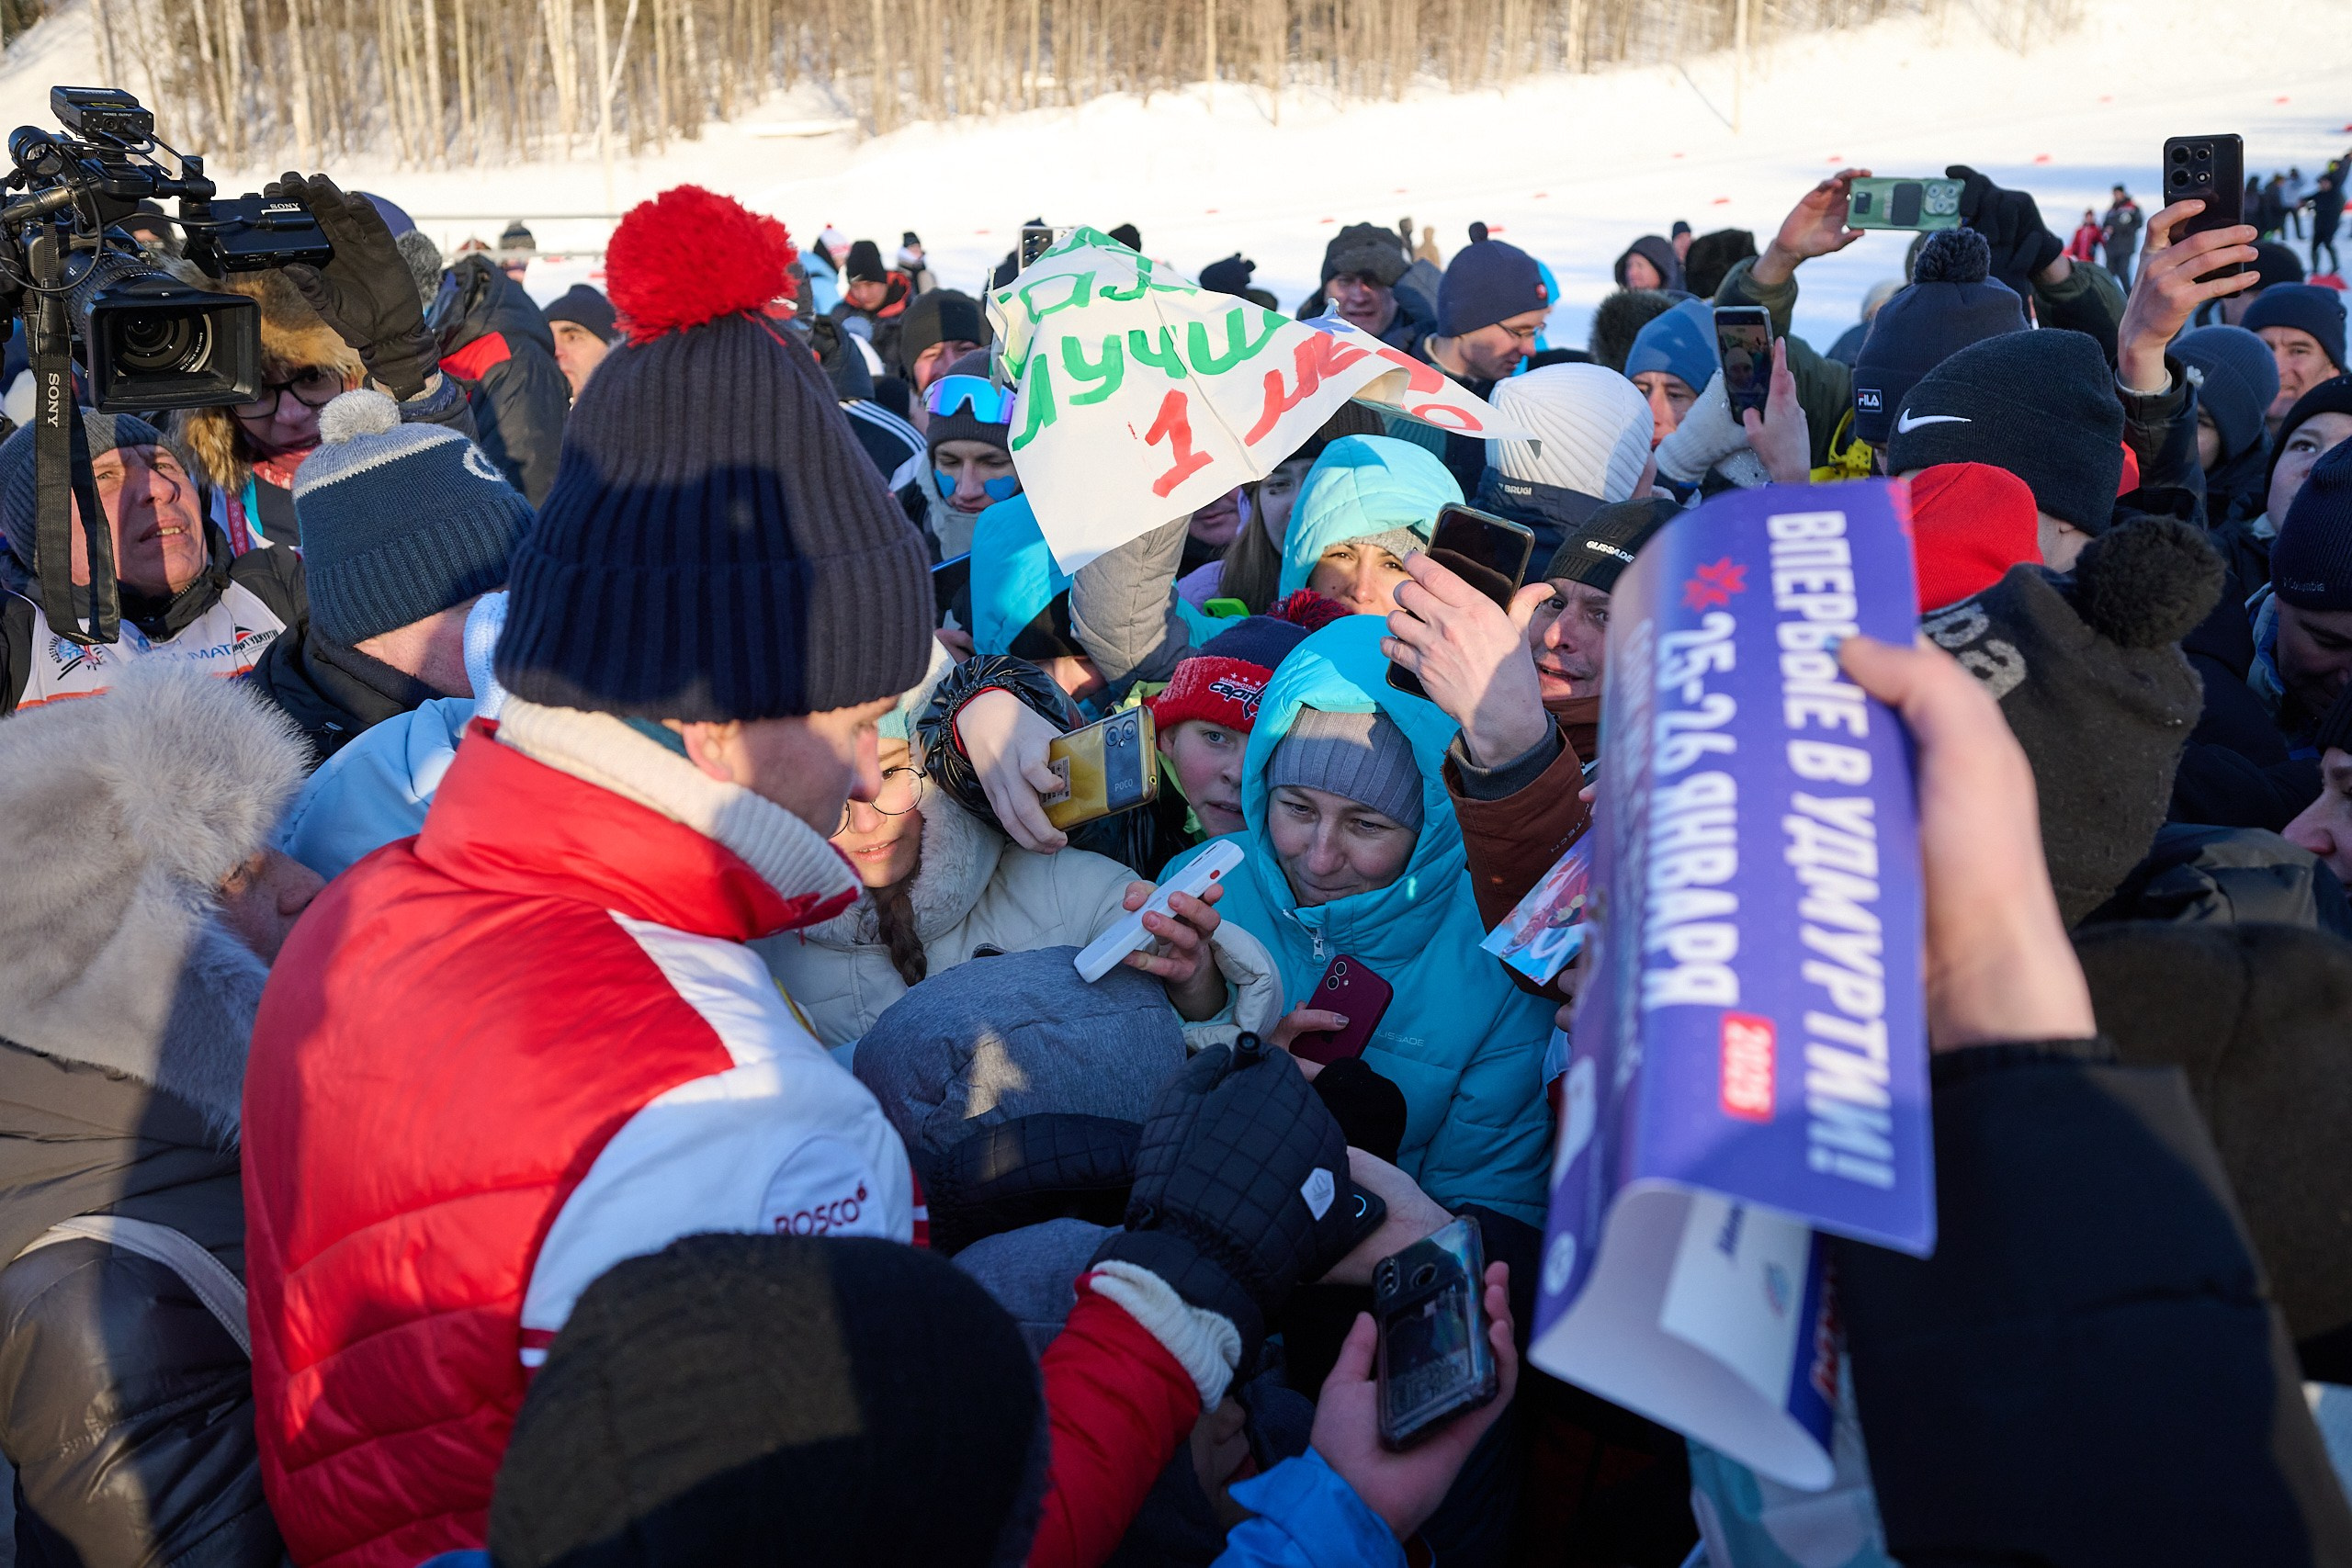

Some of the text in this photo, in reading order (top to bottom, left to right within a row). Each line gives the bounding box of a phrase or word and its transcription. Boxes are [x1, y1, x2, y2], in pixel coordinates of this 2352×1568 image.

[47, 372, 61, 428] SONY
[1858, 393, 1880, 406] FILA
[1145, 389, 1214, 499] 1
[1504, 484, 1532, 496] BRUGI
[1586, 540, 1635, 563] GLISSADE
[1219, 676, 1258, 692] WASHINGTON
[1114, 778, 1134, 792] POCO
[1642, 611, 1740, 1010] 25-26 ЯНВАРЯ
[1766, 510, 1895, 1190] ВПЕРВЫЕ В УДМУРТИИ!
